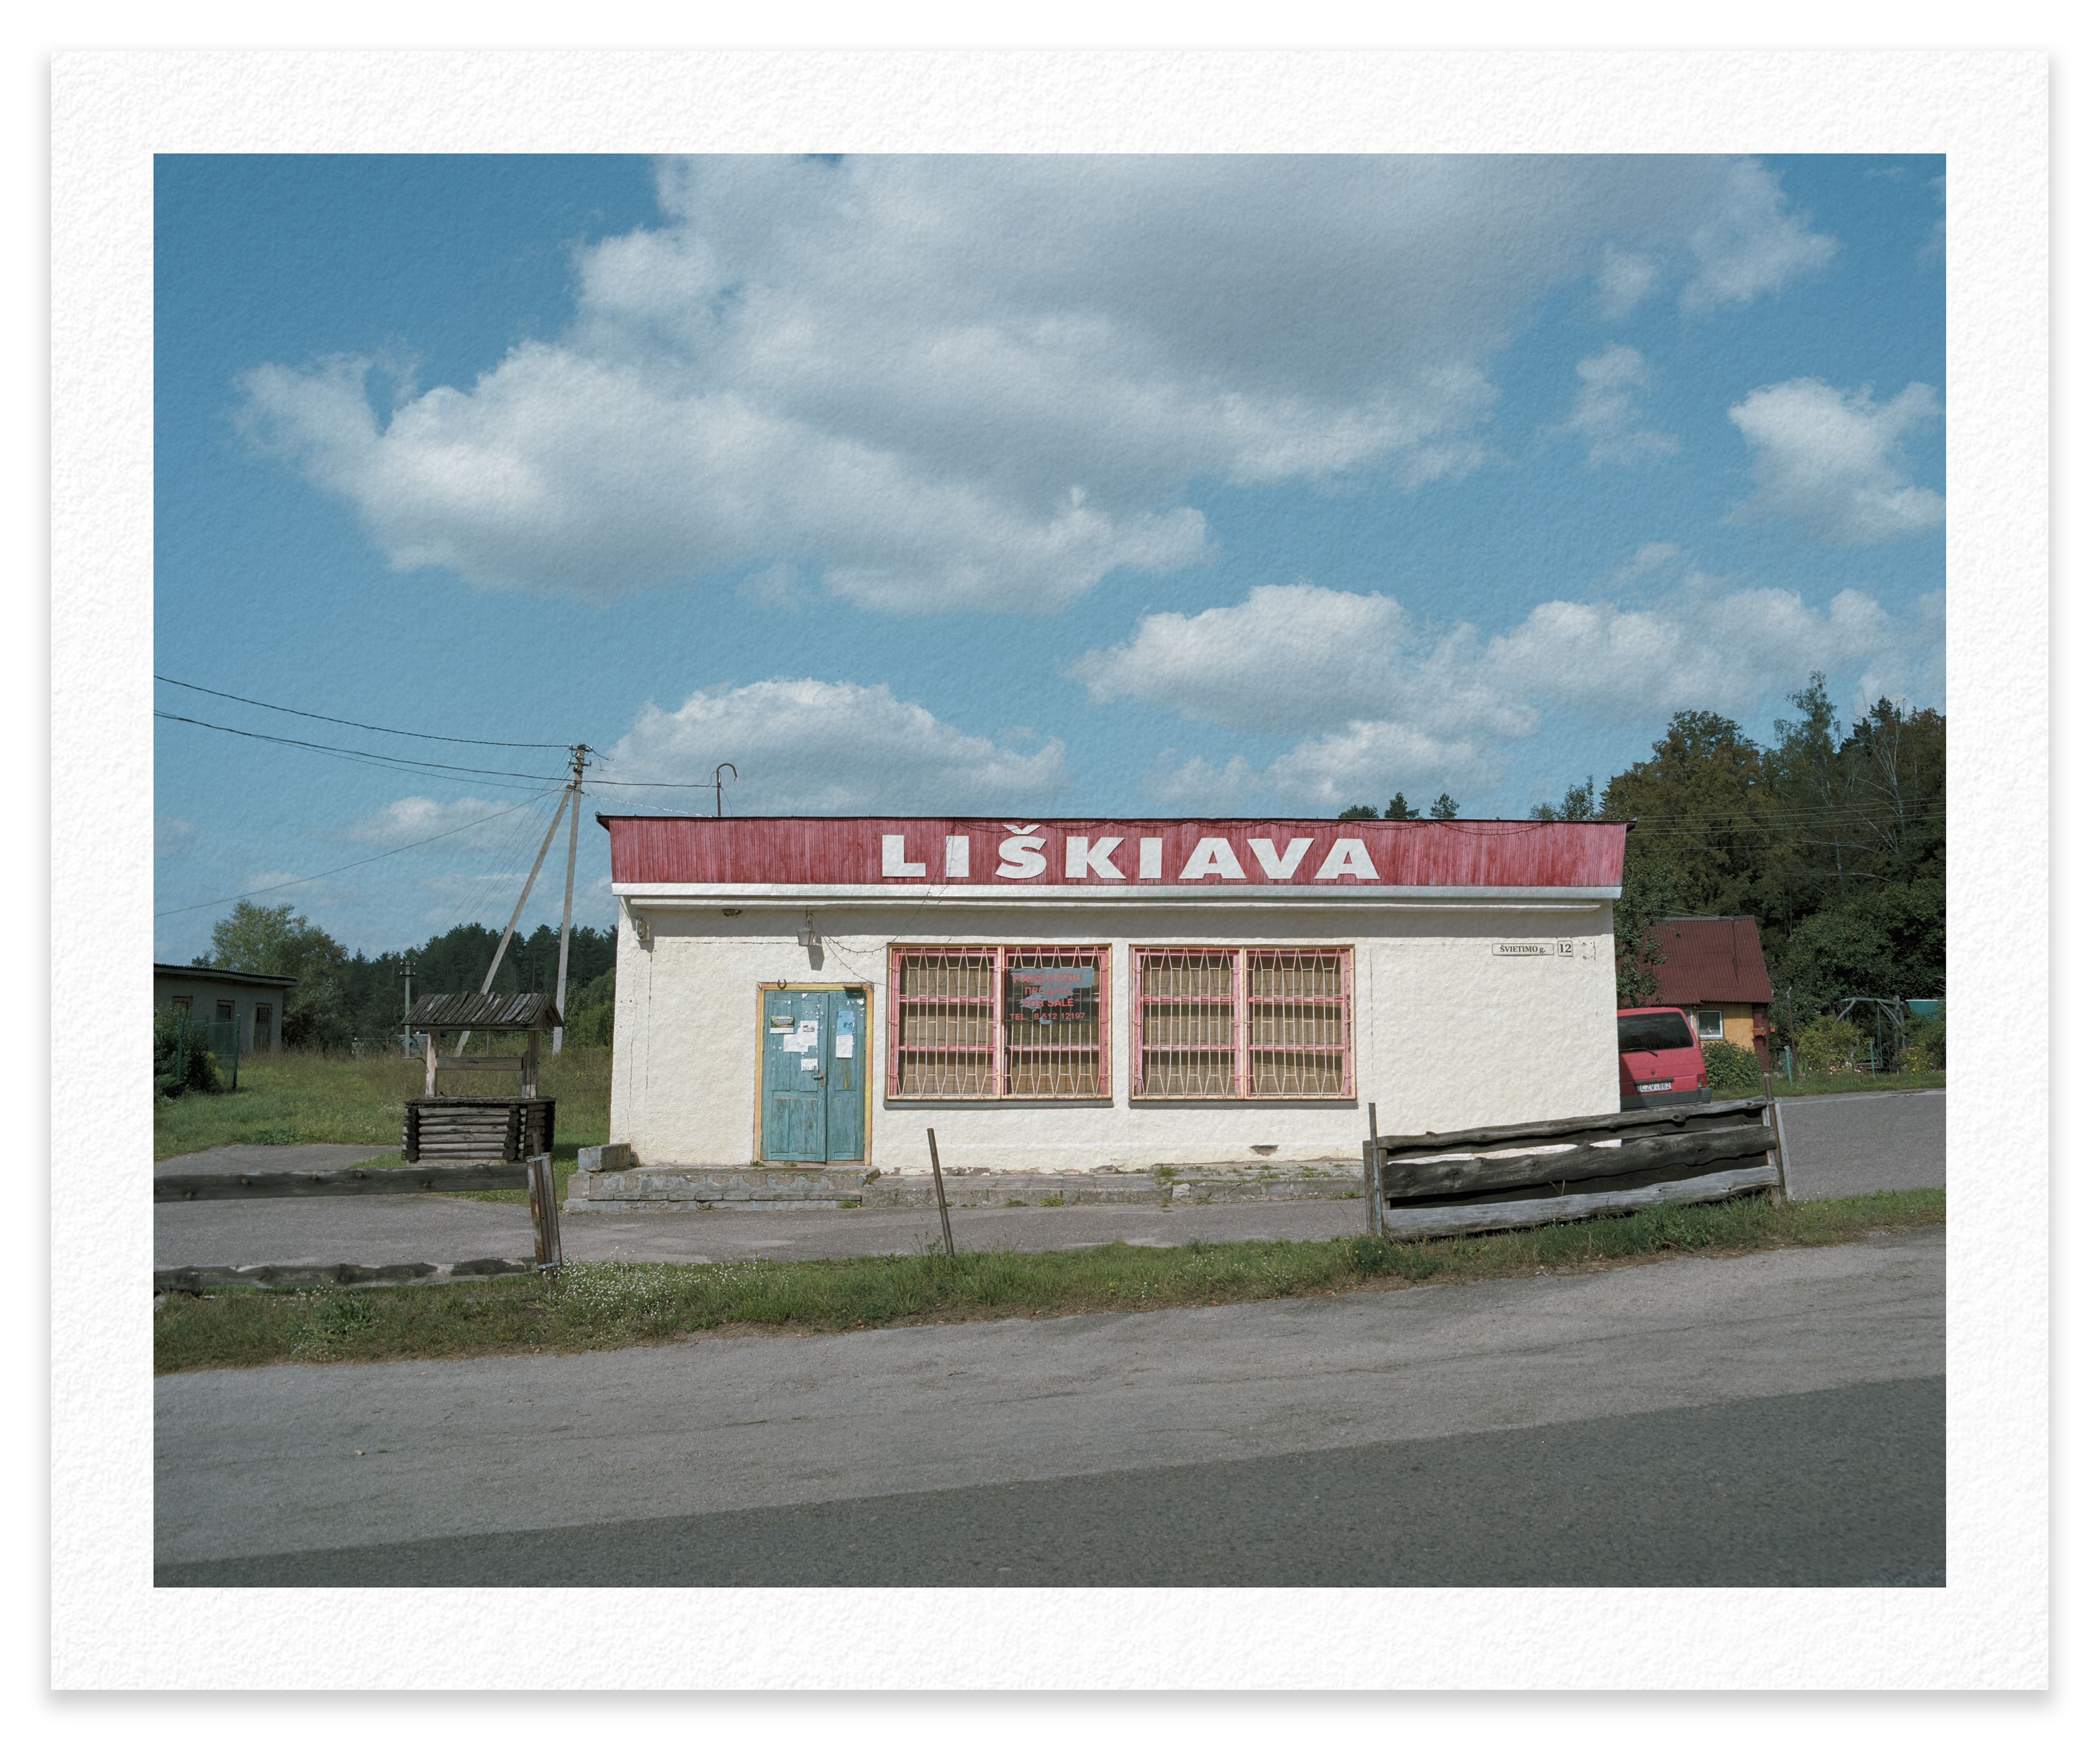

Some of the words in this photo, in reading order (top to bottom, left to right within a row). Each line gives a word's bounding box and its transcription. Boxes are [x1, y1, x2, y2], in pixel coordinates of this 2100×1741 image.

[882, 824, 1380, 879] LIŠKIAVA
[1500, 944, 1538, 953] ŠVIETIMO
[1559, 943, 1572, 953] 12
[1013, 973, 1082, 984] PARDUODU
[1024, 986, 1072, 997] ПРОДАЮ
[1022, 999, 1044, 1008] FOR
[1047, 998, 1074, 1007] SALE
